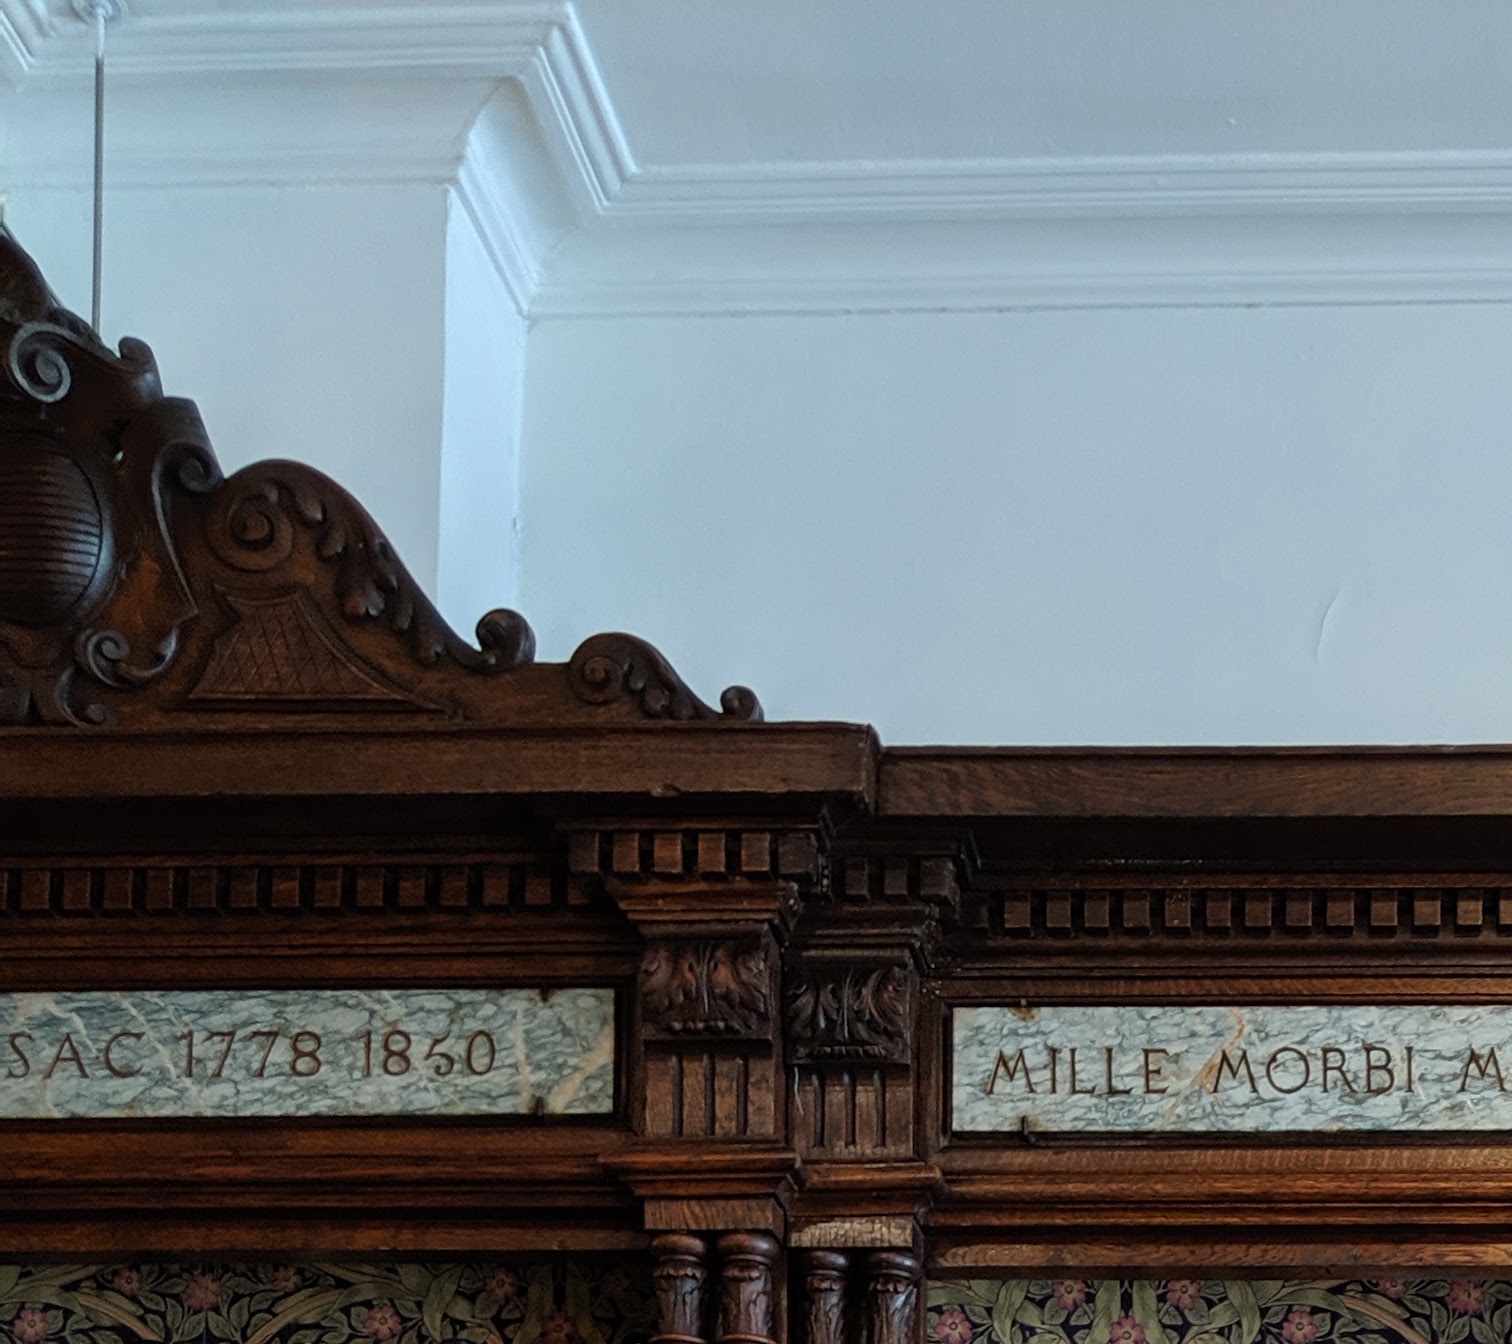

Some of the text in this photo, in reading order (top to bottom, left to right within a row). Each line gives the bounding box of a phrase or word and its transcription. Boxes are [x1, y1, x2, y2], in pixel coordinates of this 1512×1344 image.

[5, 1029, 499, 1079] SAC 1778 1850
[985, 1045, 1172, 1097] MILLE
[1209, 1044, 1415, 1096] MORBI
